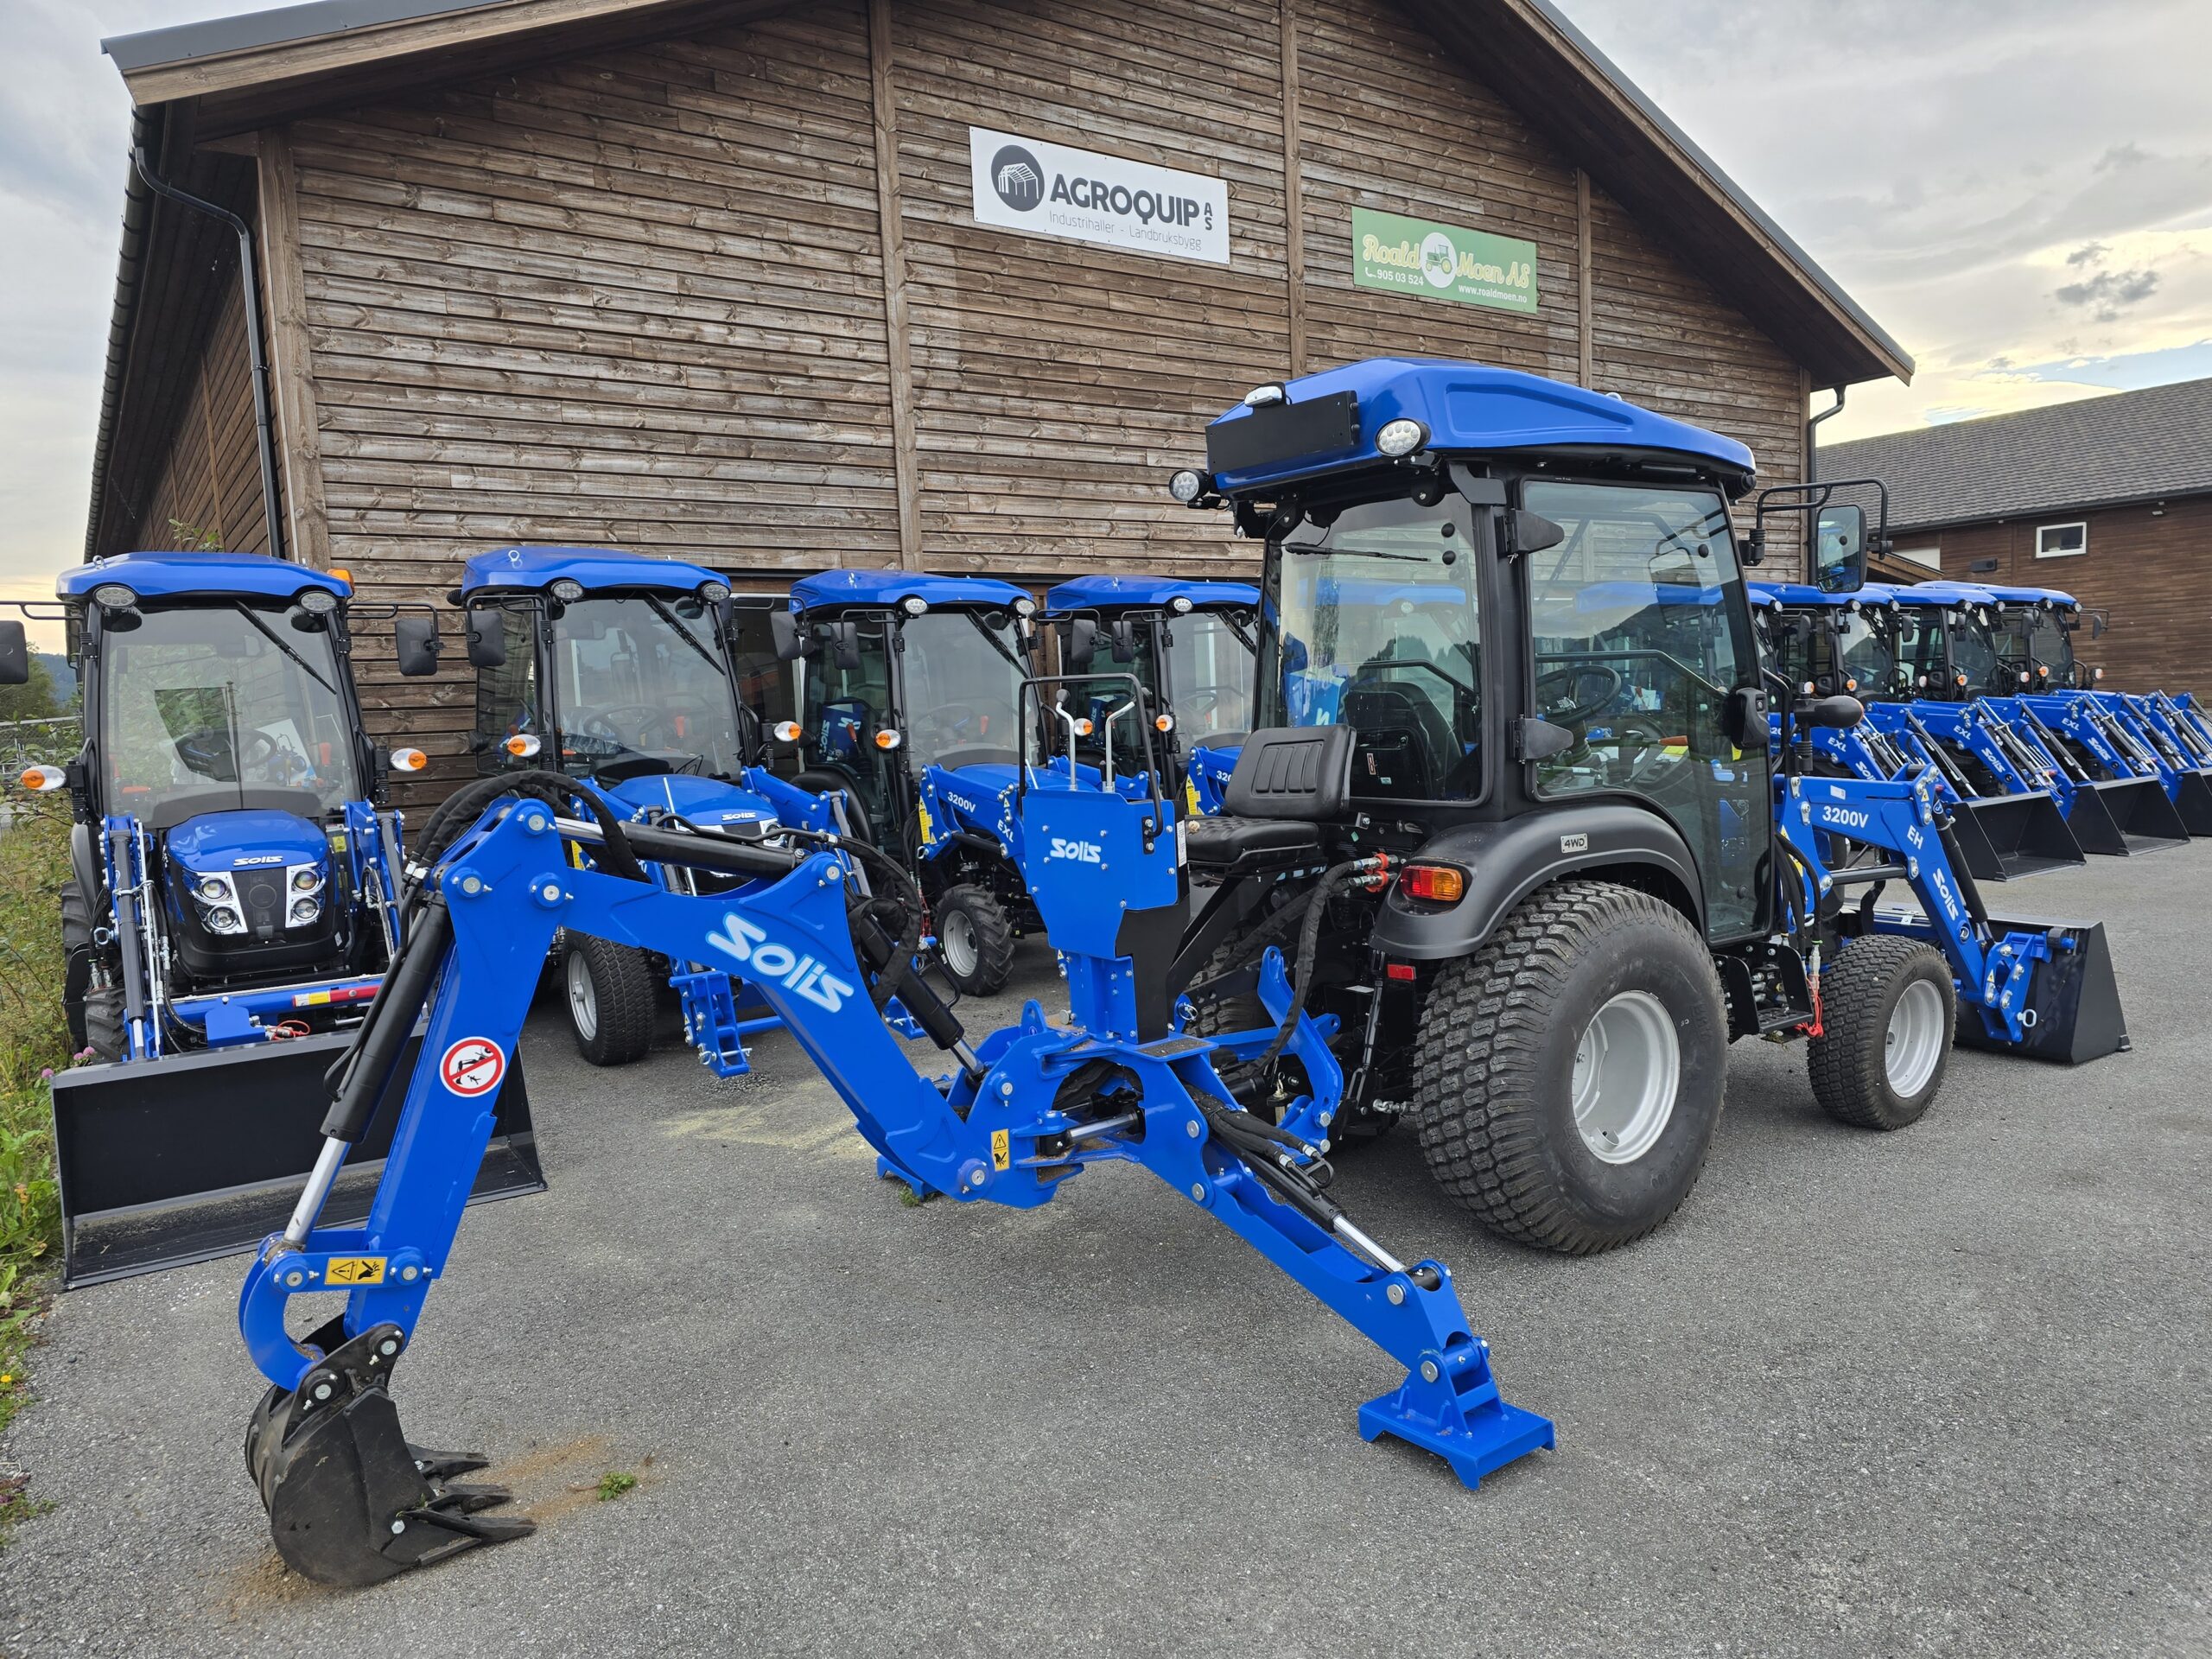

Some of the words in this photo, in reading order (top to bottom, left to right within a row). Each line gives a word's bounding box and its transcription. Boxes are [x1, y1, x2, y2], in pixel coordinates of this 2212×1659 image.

[1049, 173, 1200, 227] AGROQUIP
[1049, 210, 1115, 234] Industrihaller
[1128, 225, 1202, 251] Landbruksbygg
[1362, 233, 1422, 270] Roald
[1456, 251, 1505, 284] Moen
[1506, 261, 1531, 289] AS
[1376, 270, 1394, 281] 905
[1395, 272, 1406, 283] 03
[1408, 274, 1424, 286] 524
[1458, 283, 1528, 303] www.roaldmoen.no
[1953, 724, 1973, 741] EXL
[2061, 717, 2081, 732] EXL
[1827, 736, 1847, 753] EXL
[947, 791, 976, 813] 3200V
[1822, 805, 1869, 829] 3200V
[997, 819, 1014, 843] EXL
[1906, 824, 1924, 850] EH
[1564, 837, 1586, 849] 4WD
